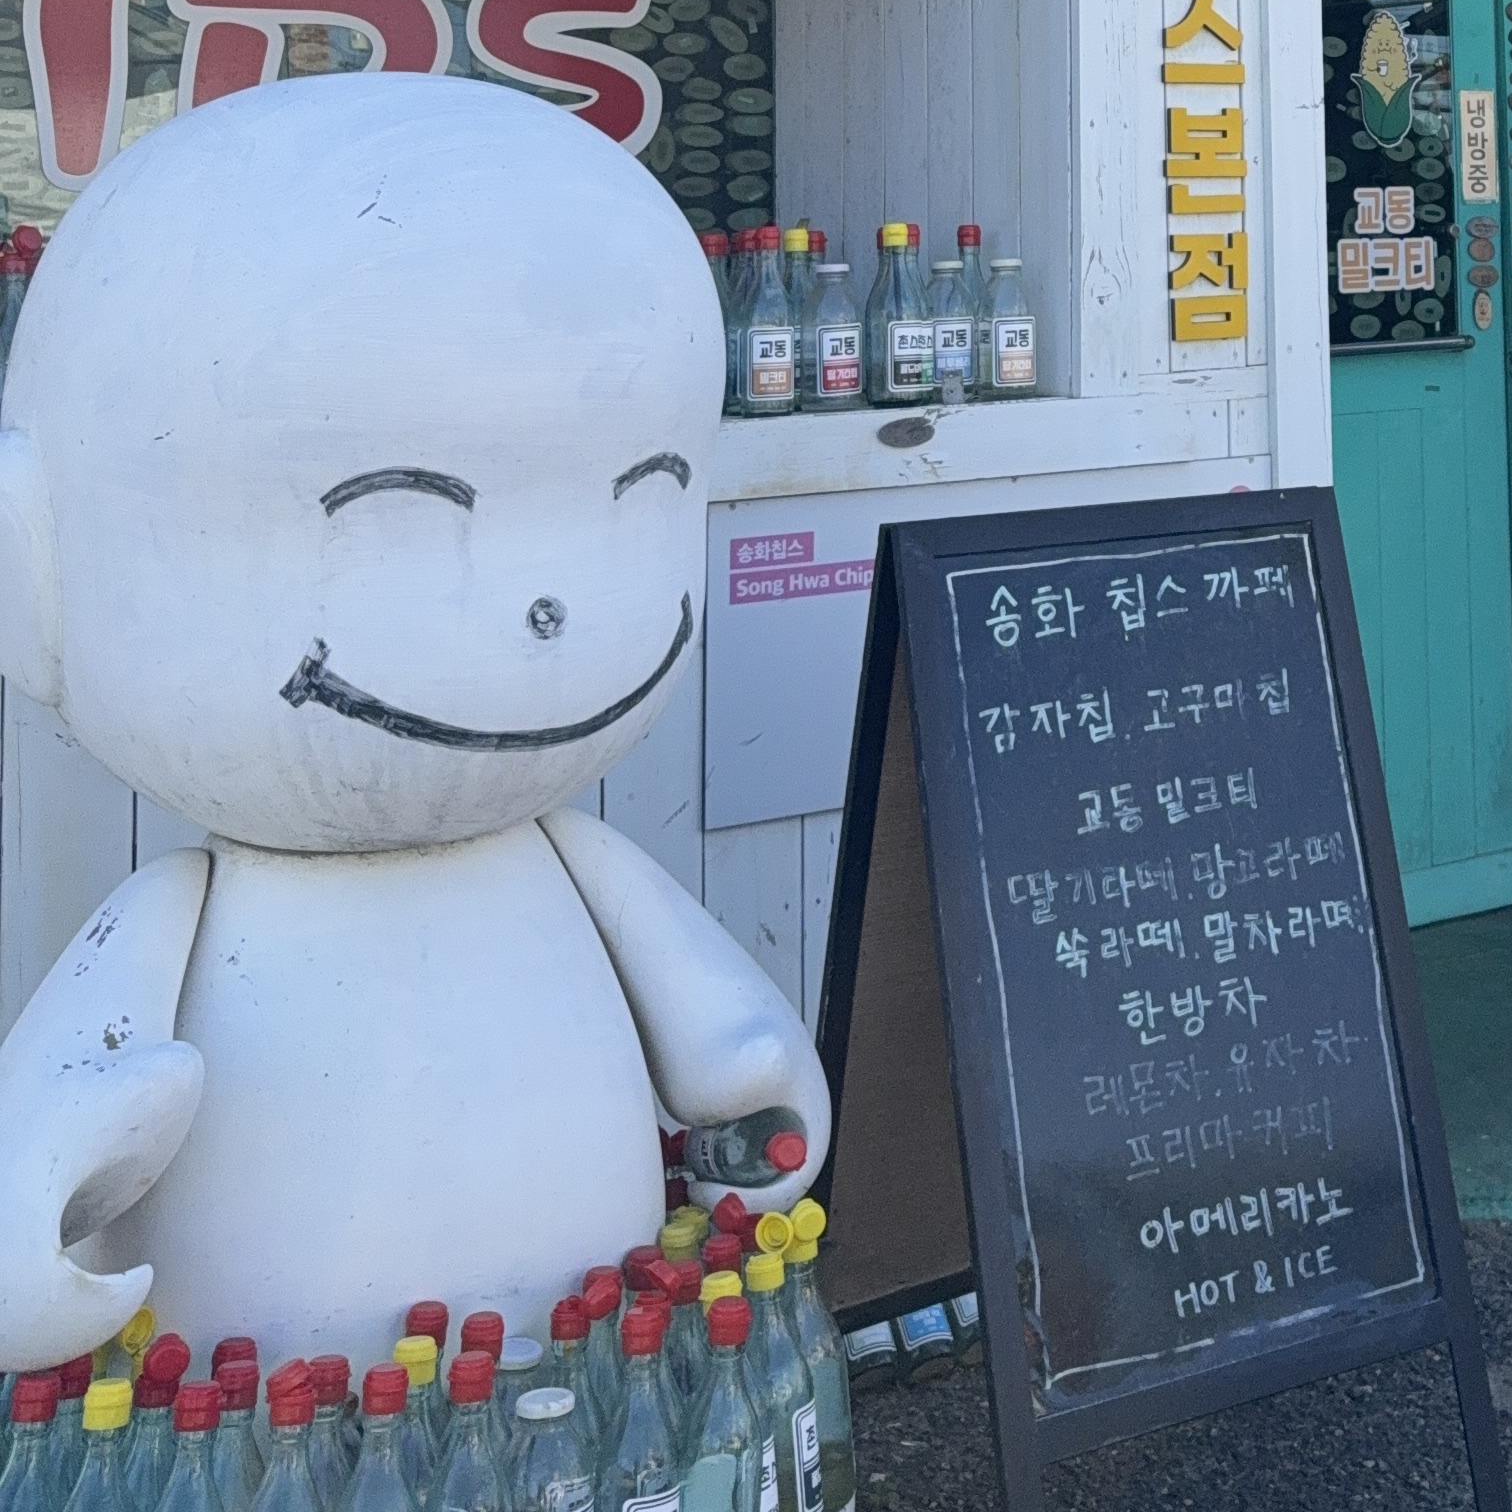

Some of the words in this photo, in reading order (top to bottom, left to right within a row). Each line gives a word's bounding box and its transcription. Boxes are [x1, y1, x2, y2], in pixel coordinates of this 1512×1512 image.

[1464, 99, 1489, 195] 냉방중
[1354, 186, 1415, 234] 교동
[1338, 236, 1435, 294] 밀크티
[759, 340, 786, 358] 교동
[829, 336, 856, 356] 교동
[942, 329, 967, 348] 교동
[1005, 329, 1029, 348] 교동
[736, 539, 804, 563] 송화칩스
[736, 579, 785, 597] Song
[789, 574, 830, 592] Hwa
[835, 566, 874, 587] Chip
[985, 585, 1086, 648] 송화
[1106, 574, 1188, 632] 칩스
[1203, 565, 1294, 608] 까페
[1077, 782, 1144, 834] 교동
[1156, 767, 1257, 825] 밀크티
[1118, 976, 1267, 1045] 한방차
[1140, 1177, 1354, 1253] 아메리카노
[1174, 1270, 1240, 1318] HOT
[1254, 1260, 1276, 1294] &
[1284, 1245, 1338, 1288] ICE
